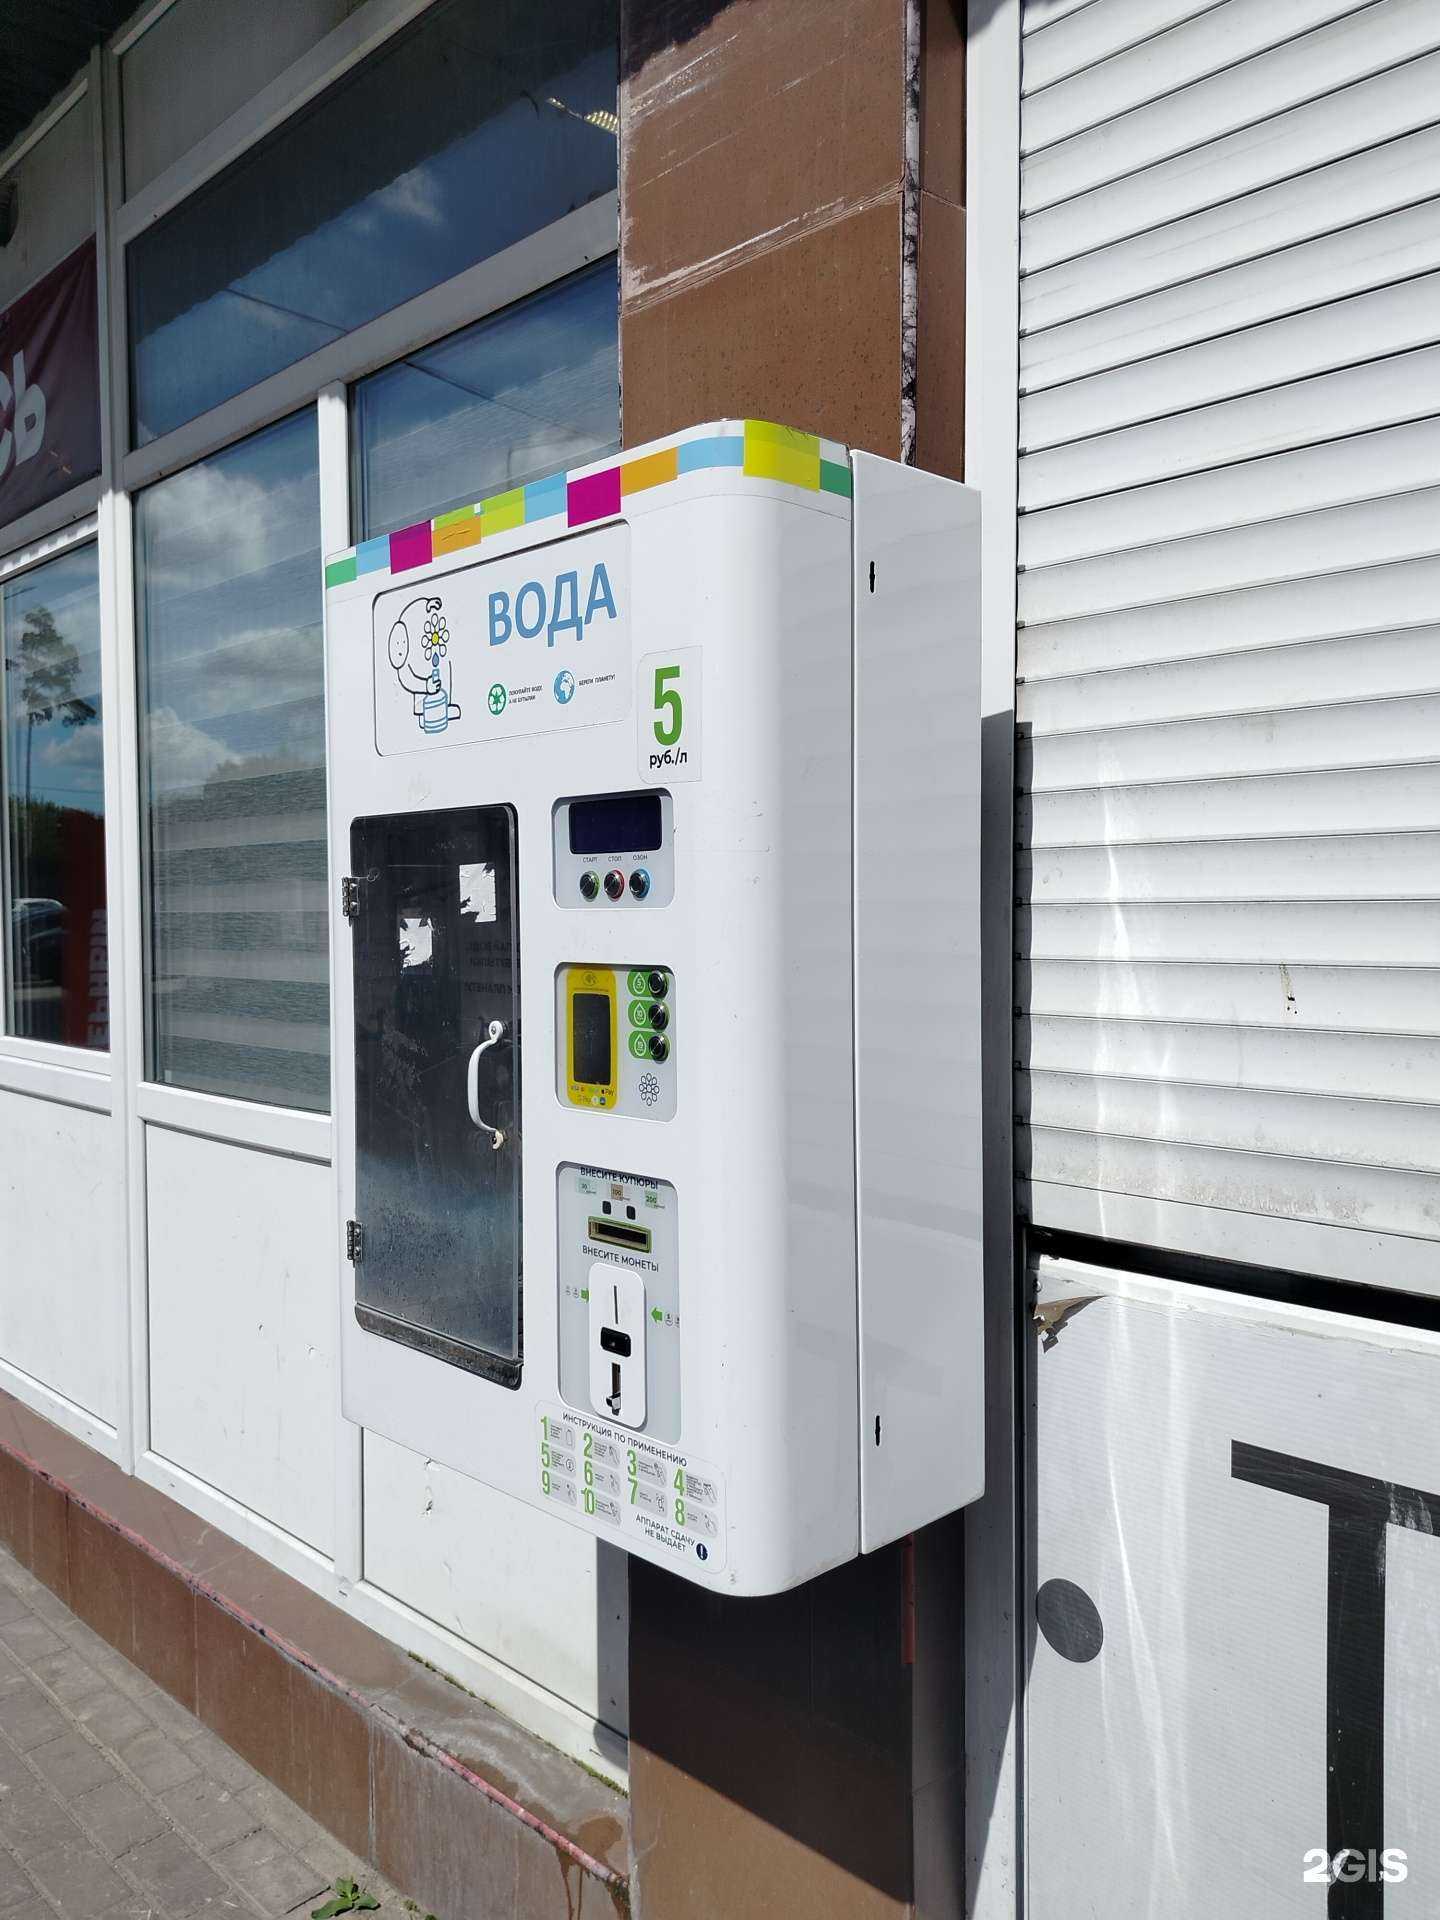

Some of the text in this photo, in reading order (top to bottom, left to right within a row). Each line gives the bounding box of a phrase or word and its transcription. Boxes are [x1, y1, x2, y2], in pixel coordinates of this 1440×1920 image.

[487, 562, 617, 648] ВОДА
[653, 664, 683, 746] 5
[649, 747, 688, 769] руб./л
[607, 855, 622, 863] СТОП
[580, 1167, 658, 1190] ВНЕСИТЕ КУПЮРЫ
[582, 1245, 659, 1272] ВНЕСИТЕ МОНЕТЫ
[540, 1416, 548, 1441] 1
[562, 1413, 612, 1438] ИНСТРУКЦИЯ
[613, 1432, 626, 1444] ПО
[627, 1437, 688, 1467] ПРИМЕНЕНИЮ
[541, 1442, 550, 1468] 5
[583, 1432, 593, 1459] 2
[584, 1461, 593, 1486] 6
[626, 1449, 637, 1476] 3
[542, 1470, 550, 1495] 9
[627, 1477, 638, 1505] 7
[674, 1468, 685, 1496] 4
[580, 1487, 595, 1515] 10
[675, 1498, 685, 1527] 8
[636, 1513, 669, 1535] АППАРАТ
[670, 1529, 696, 1547] СДАЧУ
[644, 1528, 687, 1552] НЕ ВЫДАЕТ
